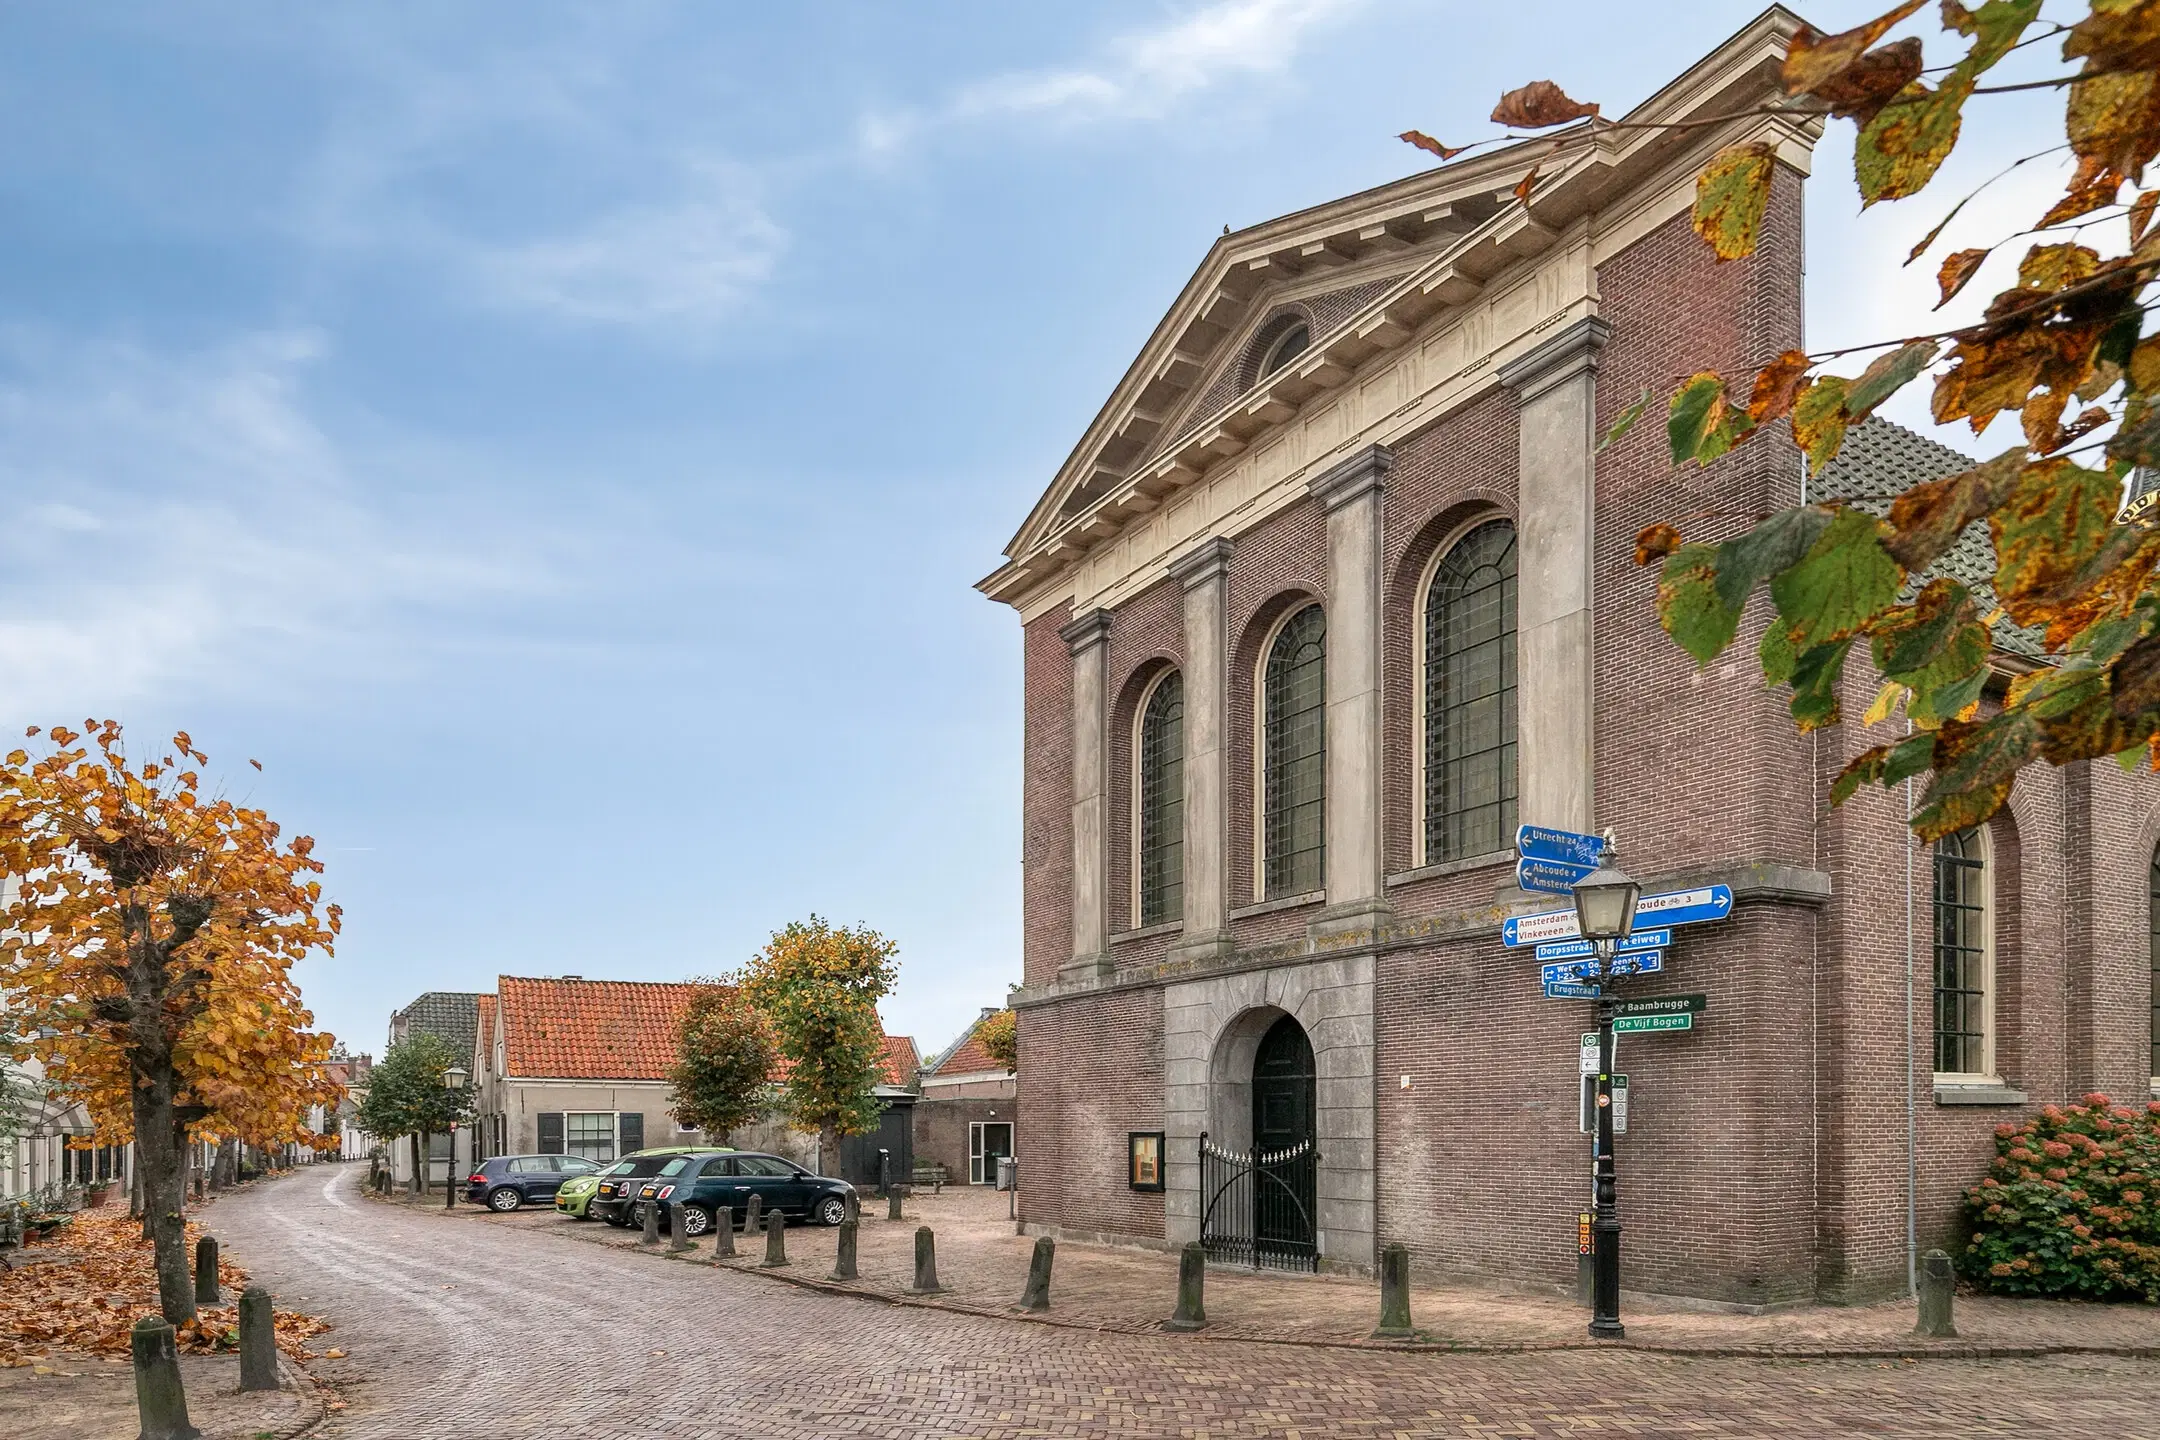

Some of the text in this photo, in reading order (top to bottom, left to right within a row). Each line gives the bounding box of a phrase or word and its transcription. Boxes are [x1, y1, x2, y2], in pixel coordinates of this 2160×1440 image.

[1532, 830, 1576, 845] Utrecht 24
[1533, 863, 1576, 878] Abcoude 4
[1532, 877, 1573, 890] Amsterda
[1685, 895, 1692, 903] 3
[1518, 914, 1568, 928] Amsterdam
[1518, 927, 1564, 939] Vinkeveen
[1622, 934, 1661, 946] Keiweg
[1554, 984, 1595, 995] Brugstraat
[1627, 999, 1690, 1011] Baambrugge
[1618, 1018, 1684, 1028] De Vijf Bogen
